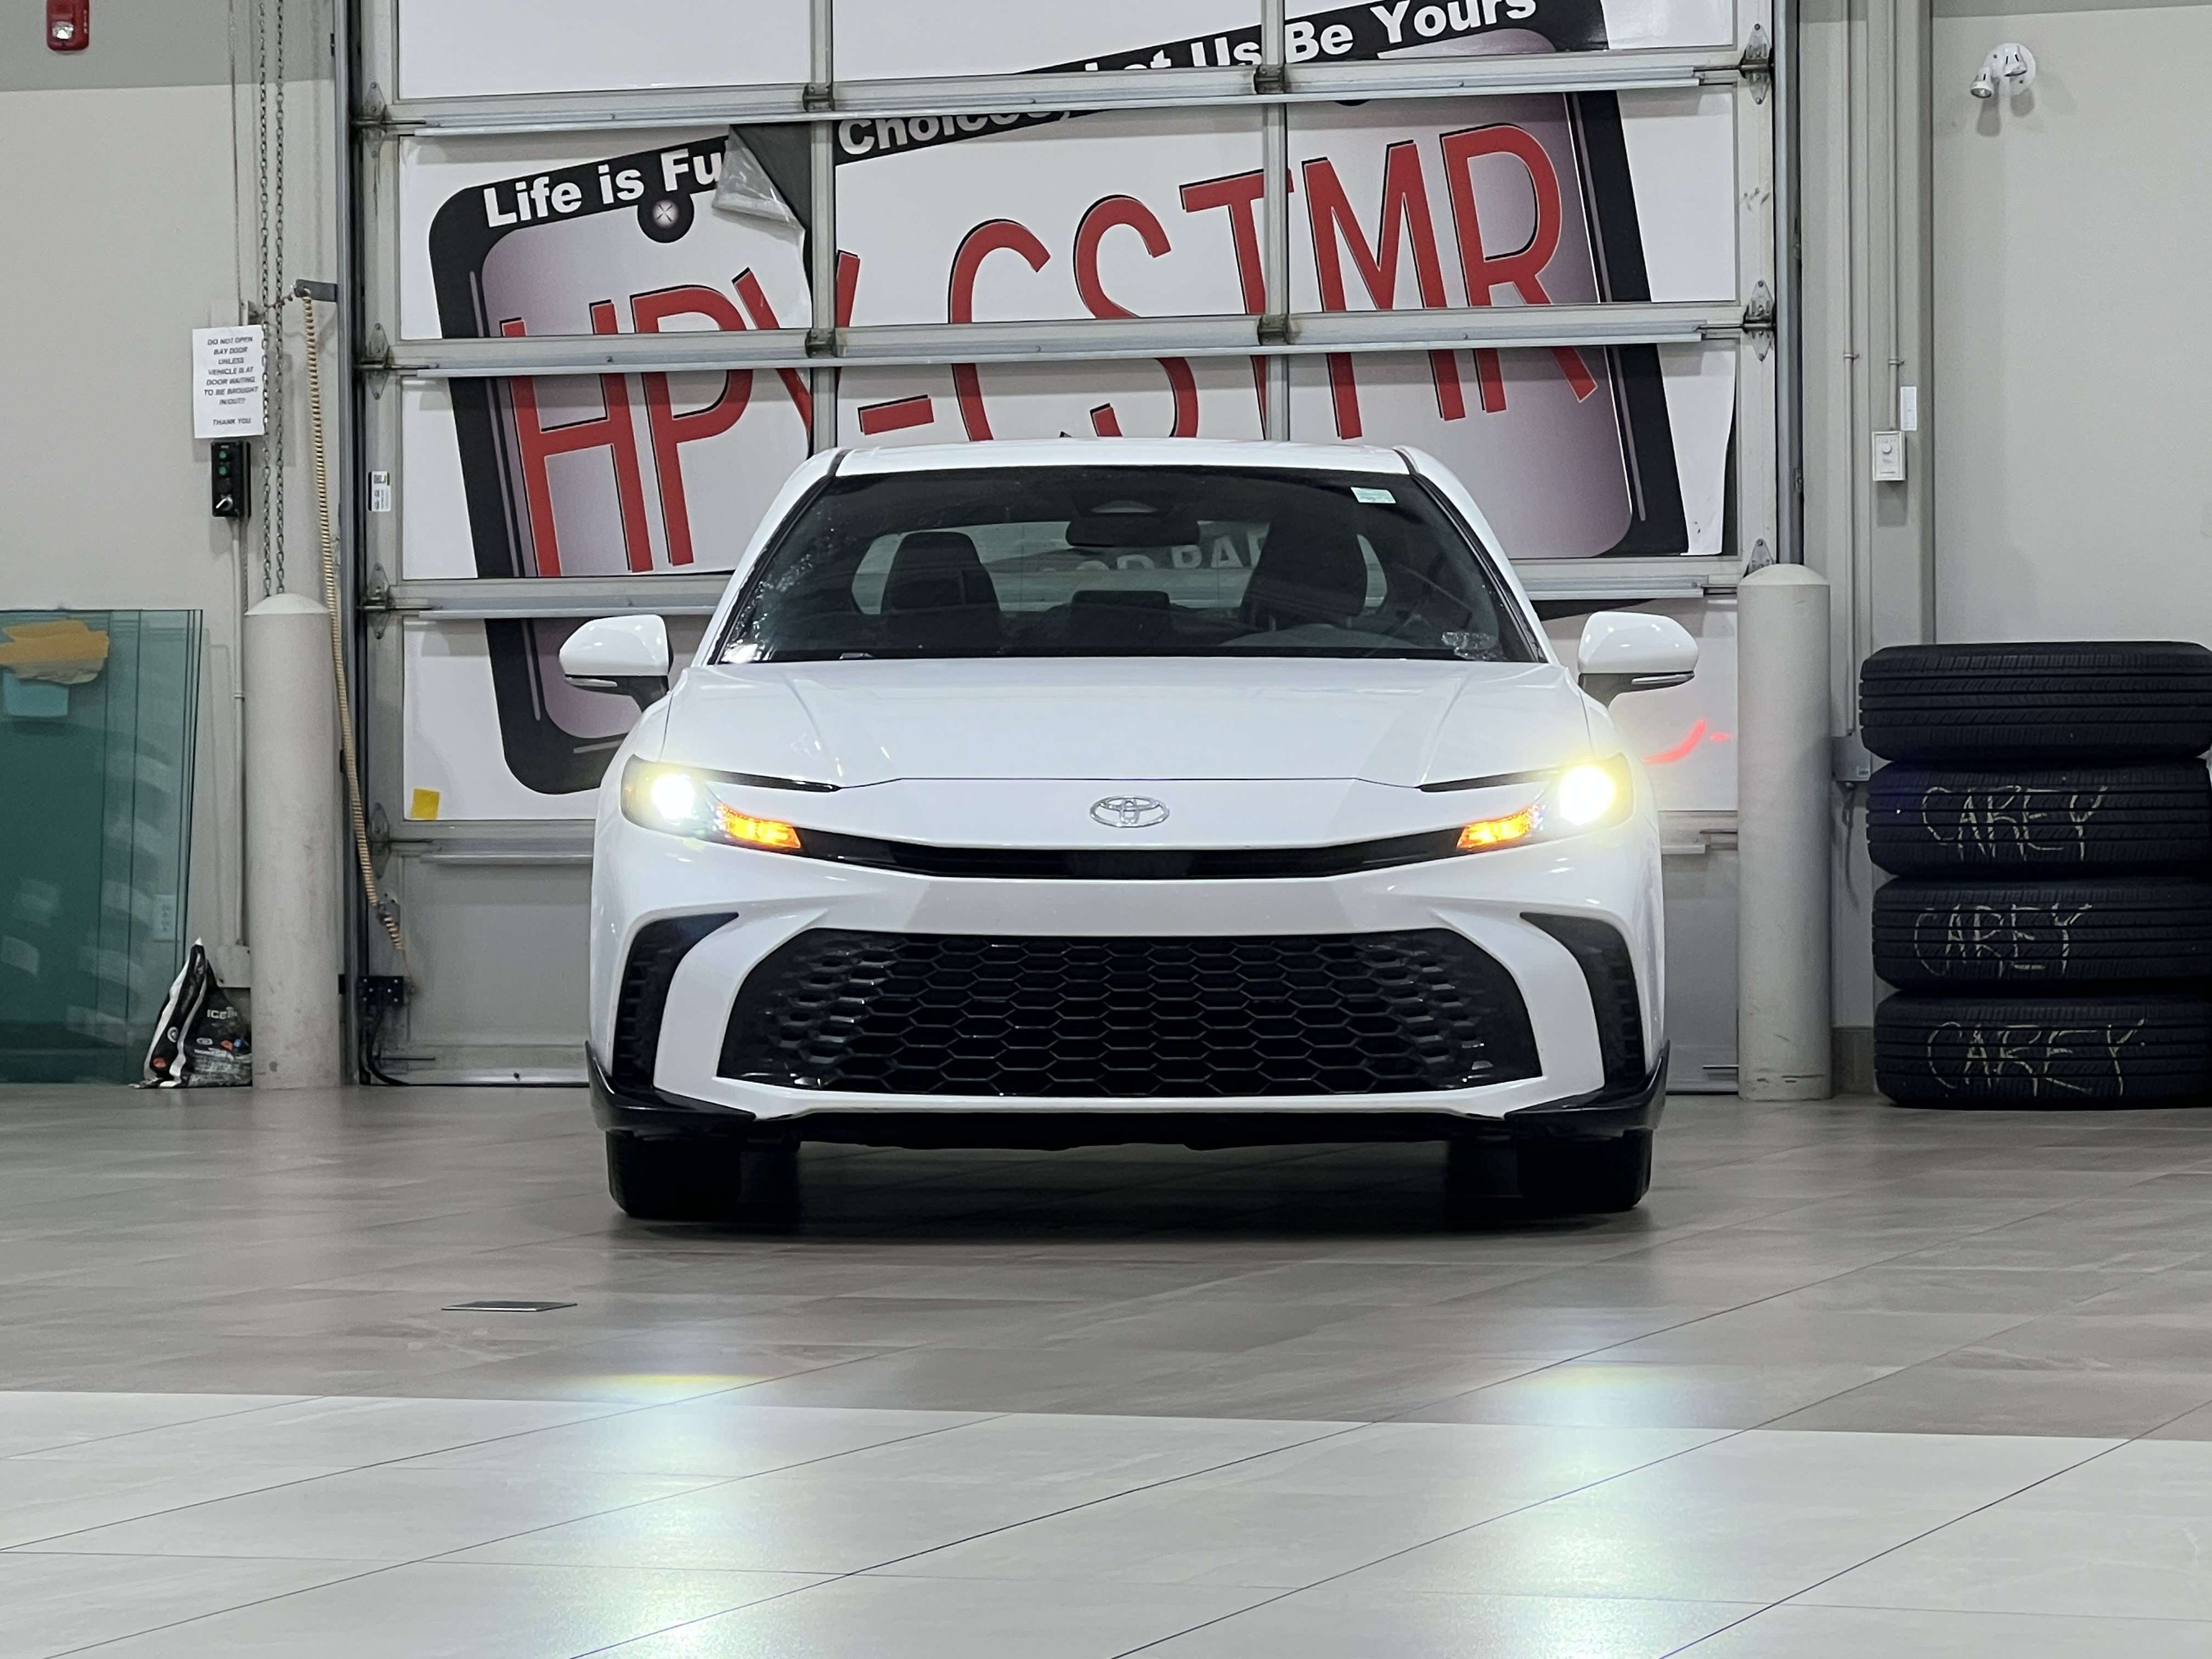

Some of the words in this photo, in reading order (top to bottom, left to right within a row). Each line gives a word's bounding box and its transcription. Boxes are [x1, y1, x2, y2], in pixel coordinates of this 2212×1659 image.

[483, 176, 582, 228] Life
[597, 165, 645, 205] is
[661, 148, 723, 192] Fu
[1284, 21, 1353, 64] Be
[1370, 0, 1536, 44] Yours
[1922, 786, 2108, 861] CAREY
[1914, 903, 2092, 979] CAREY
[1927, 1019, 2146, 1097] CAREY
